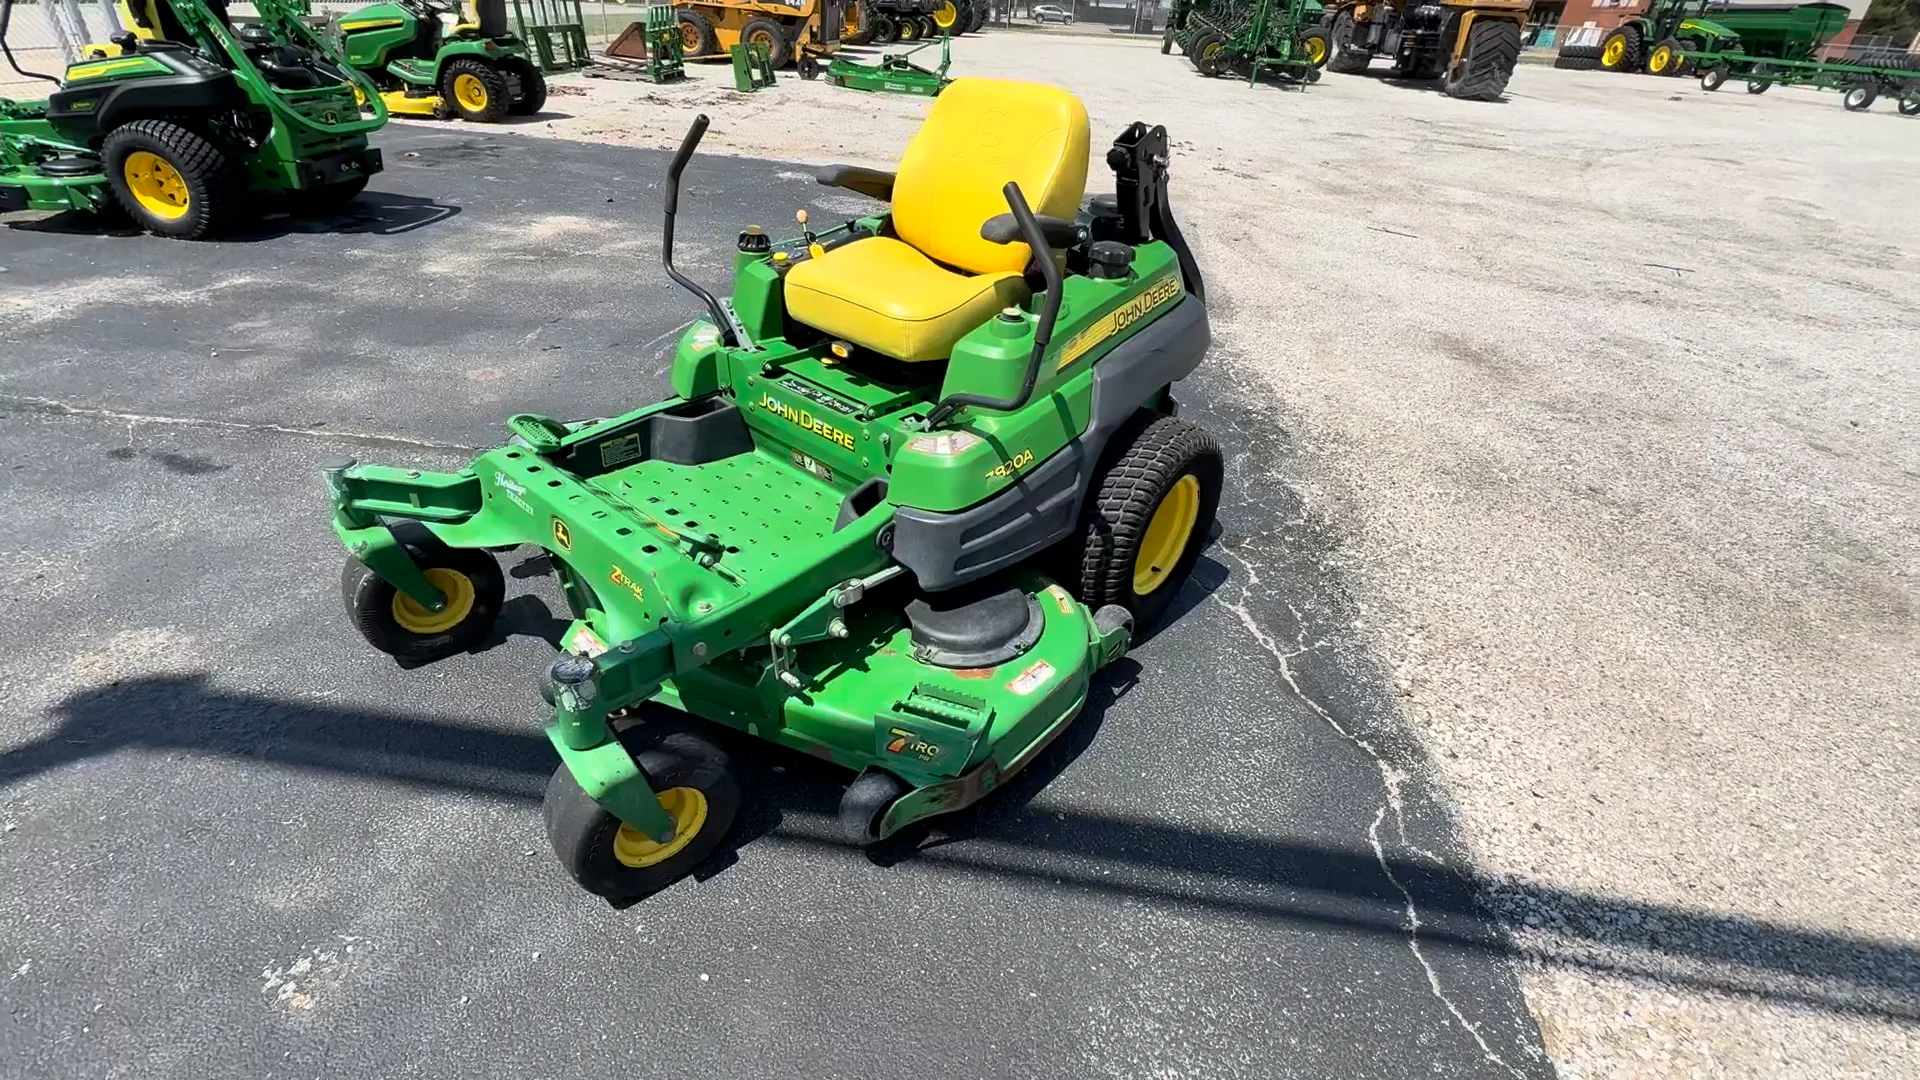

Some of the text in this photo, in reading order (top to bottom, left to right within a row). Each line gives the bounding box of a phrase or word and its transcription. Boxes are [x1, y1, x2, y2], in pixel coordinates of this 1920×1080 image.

[1110, 277, 1179, 335] JOHN DEERE
[759, 391, 799, 425] JOHN
[800, 409, 854, 452] DEERE
